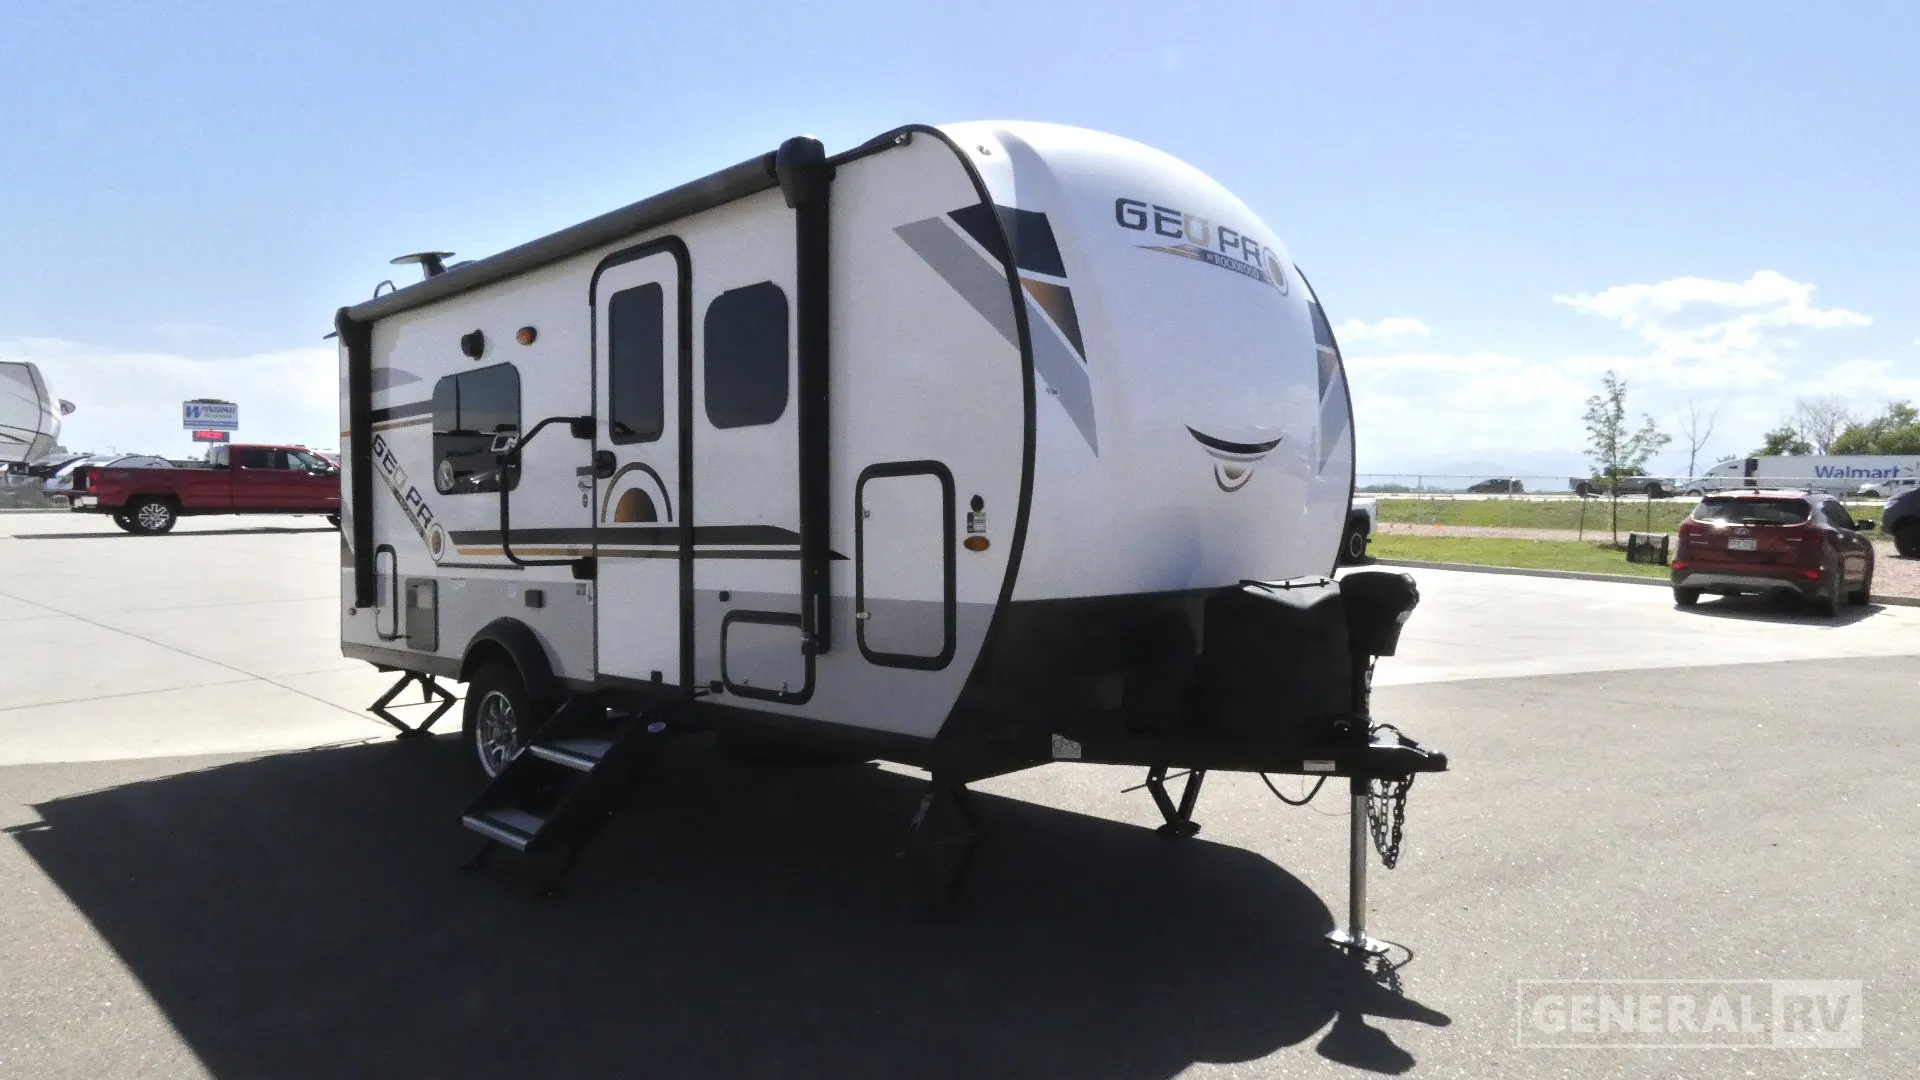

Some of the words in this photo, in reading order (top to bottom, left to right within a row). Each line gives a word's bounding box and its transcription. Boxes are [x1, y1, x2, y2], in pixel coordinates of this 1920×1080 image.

[1115, 198, 1211, 246] GEO
[1218, 226, 1288, 296] PRO
[373, 434, 408, 490] GEO
[406, 485, 445, 561] PRO
[1814, 465, 1900, 478] Walmart
